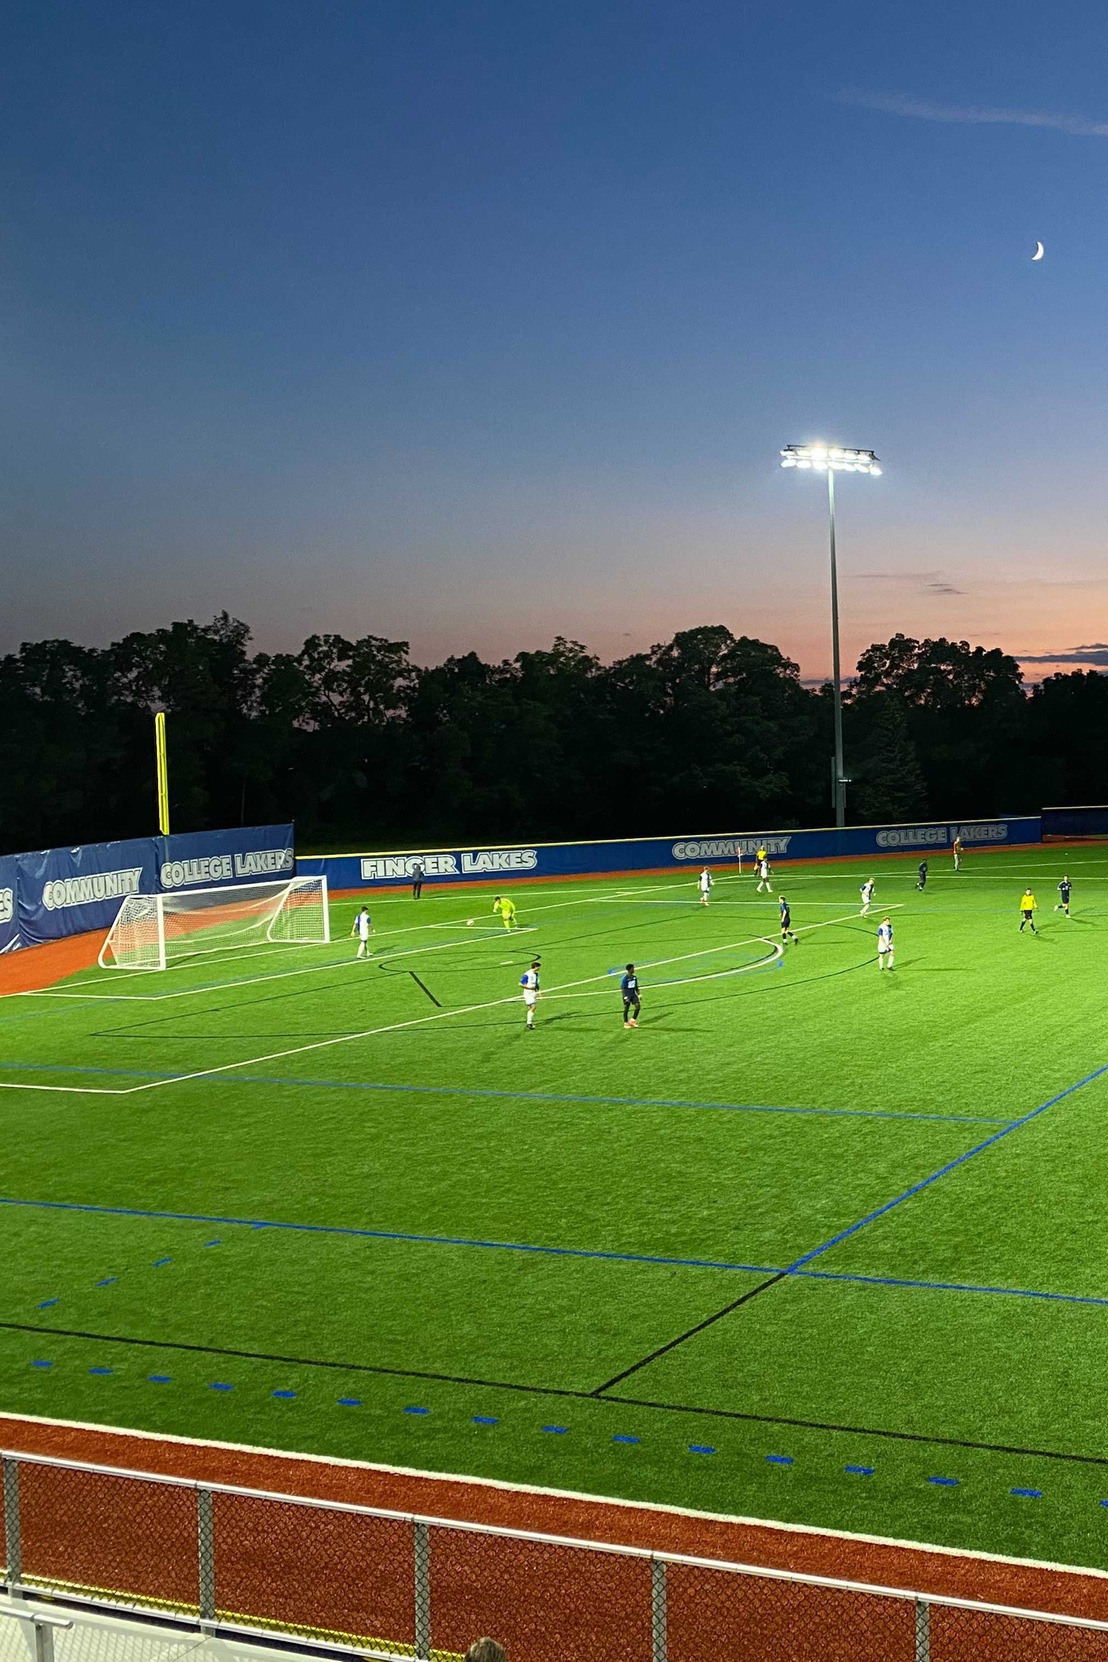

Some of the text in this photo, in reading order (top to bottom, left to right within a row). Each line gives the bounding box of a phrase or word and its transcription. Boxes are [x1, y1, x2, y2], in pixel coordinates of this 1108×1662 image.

[672, 836, 792, 860] COMMUNITY
[876, 824, 1008, 847] COLLEGE LAKERS
[160, 847, 294, 888] COLLEGE LAKERS
[360, 849, 537, 880] FINGER LAKES
[42, 866, 143, 911] COMMUNITY
